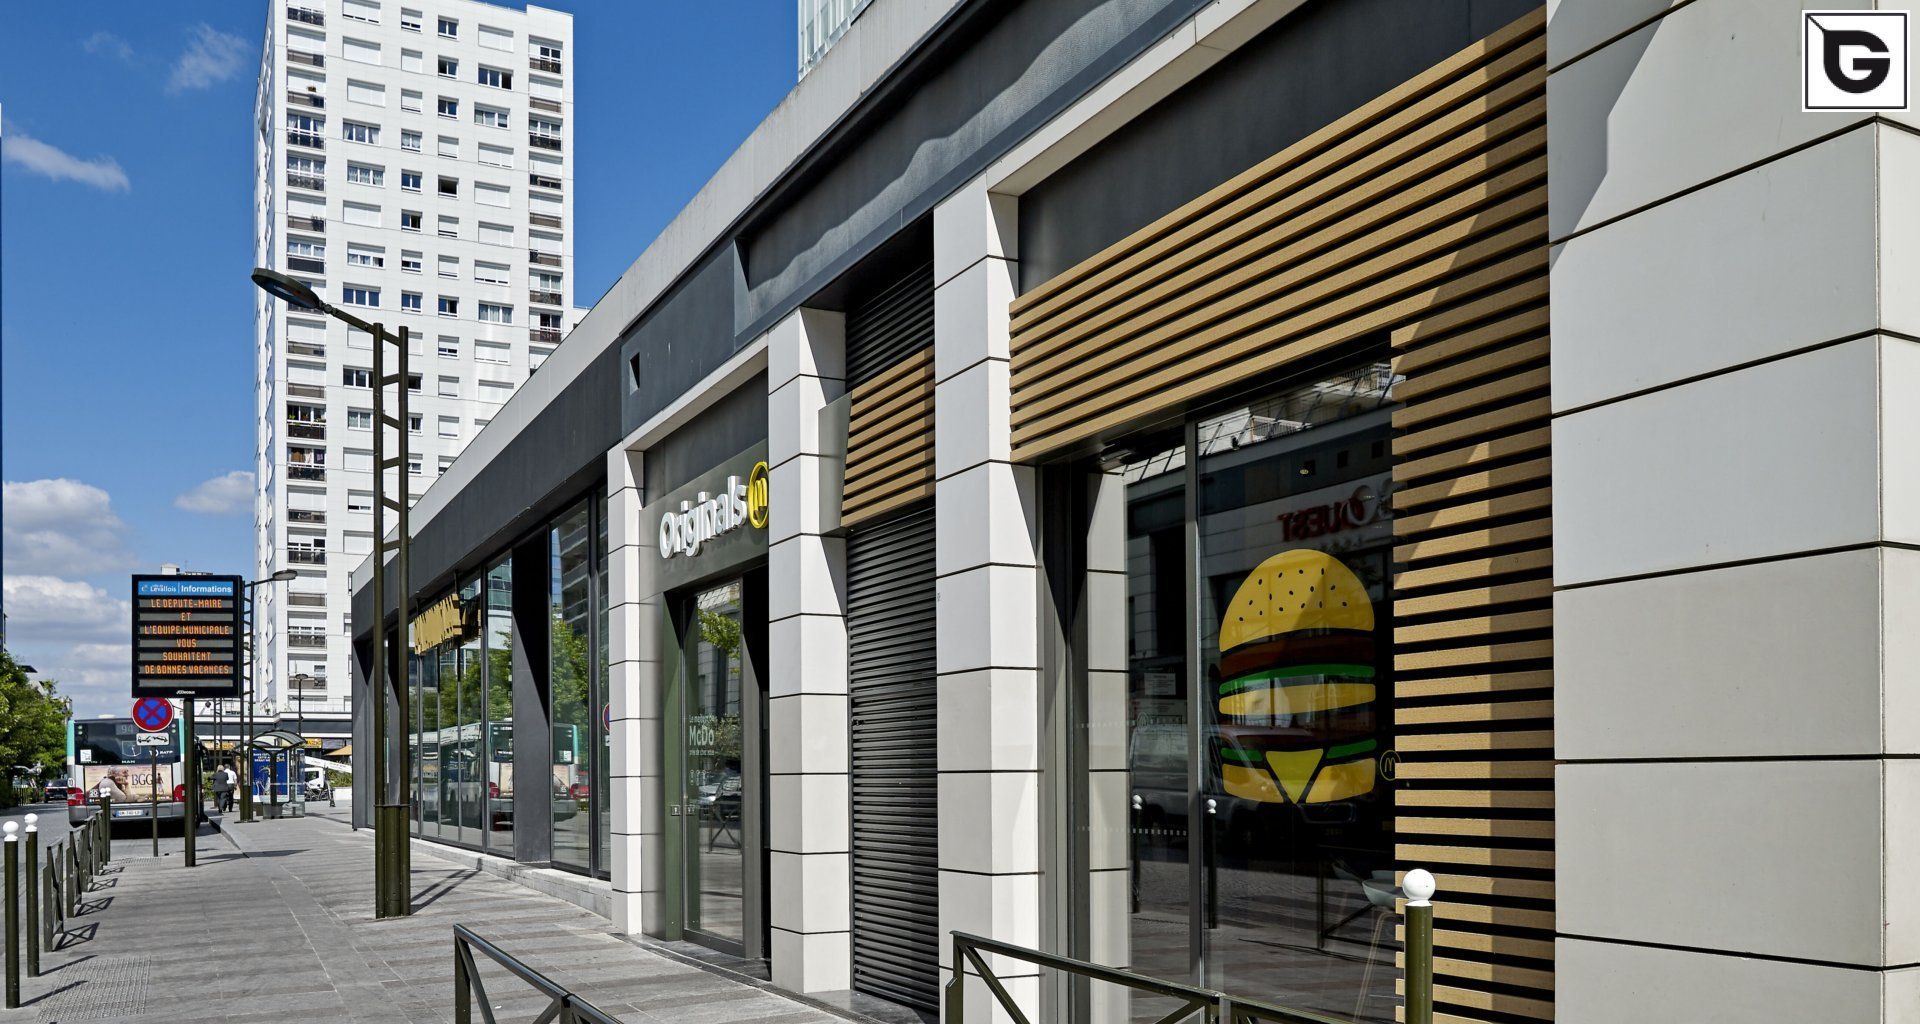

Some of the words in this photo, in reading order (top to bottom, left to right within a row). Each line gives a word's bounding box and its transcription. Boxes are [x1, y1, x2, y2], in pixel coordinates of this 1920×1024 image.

[660, 476, 747, 558] Originals
[150, 585, 176, 593] Levallois
[181, 585, 232, 593] Informations
[151, 599, 160, 608] LE
[163, 599, 222, 608] DEPUTE-MAIRE
[181, 612, 191, 621] ET
[144, 625, 180, 634] L'EQUIPE
[183, 625, 229, 634] MUNICIPALE
[177, 639, 197, 647] VOUS
[163, 652, 212, 661] SOUHAITENT
[145, 665, 155, 674] DE
[157, 665, 187, 674] BONNES
[189, 665, 229, 674] VACANCES
[689, 725, 714, 746] McDo
